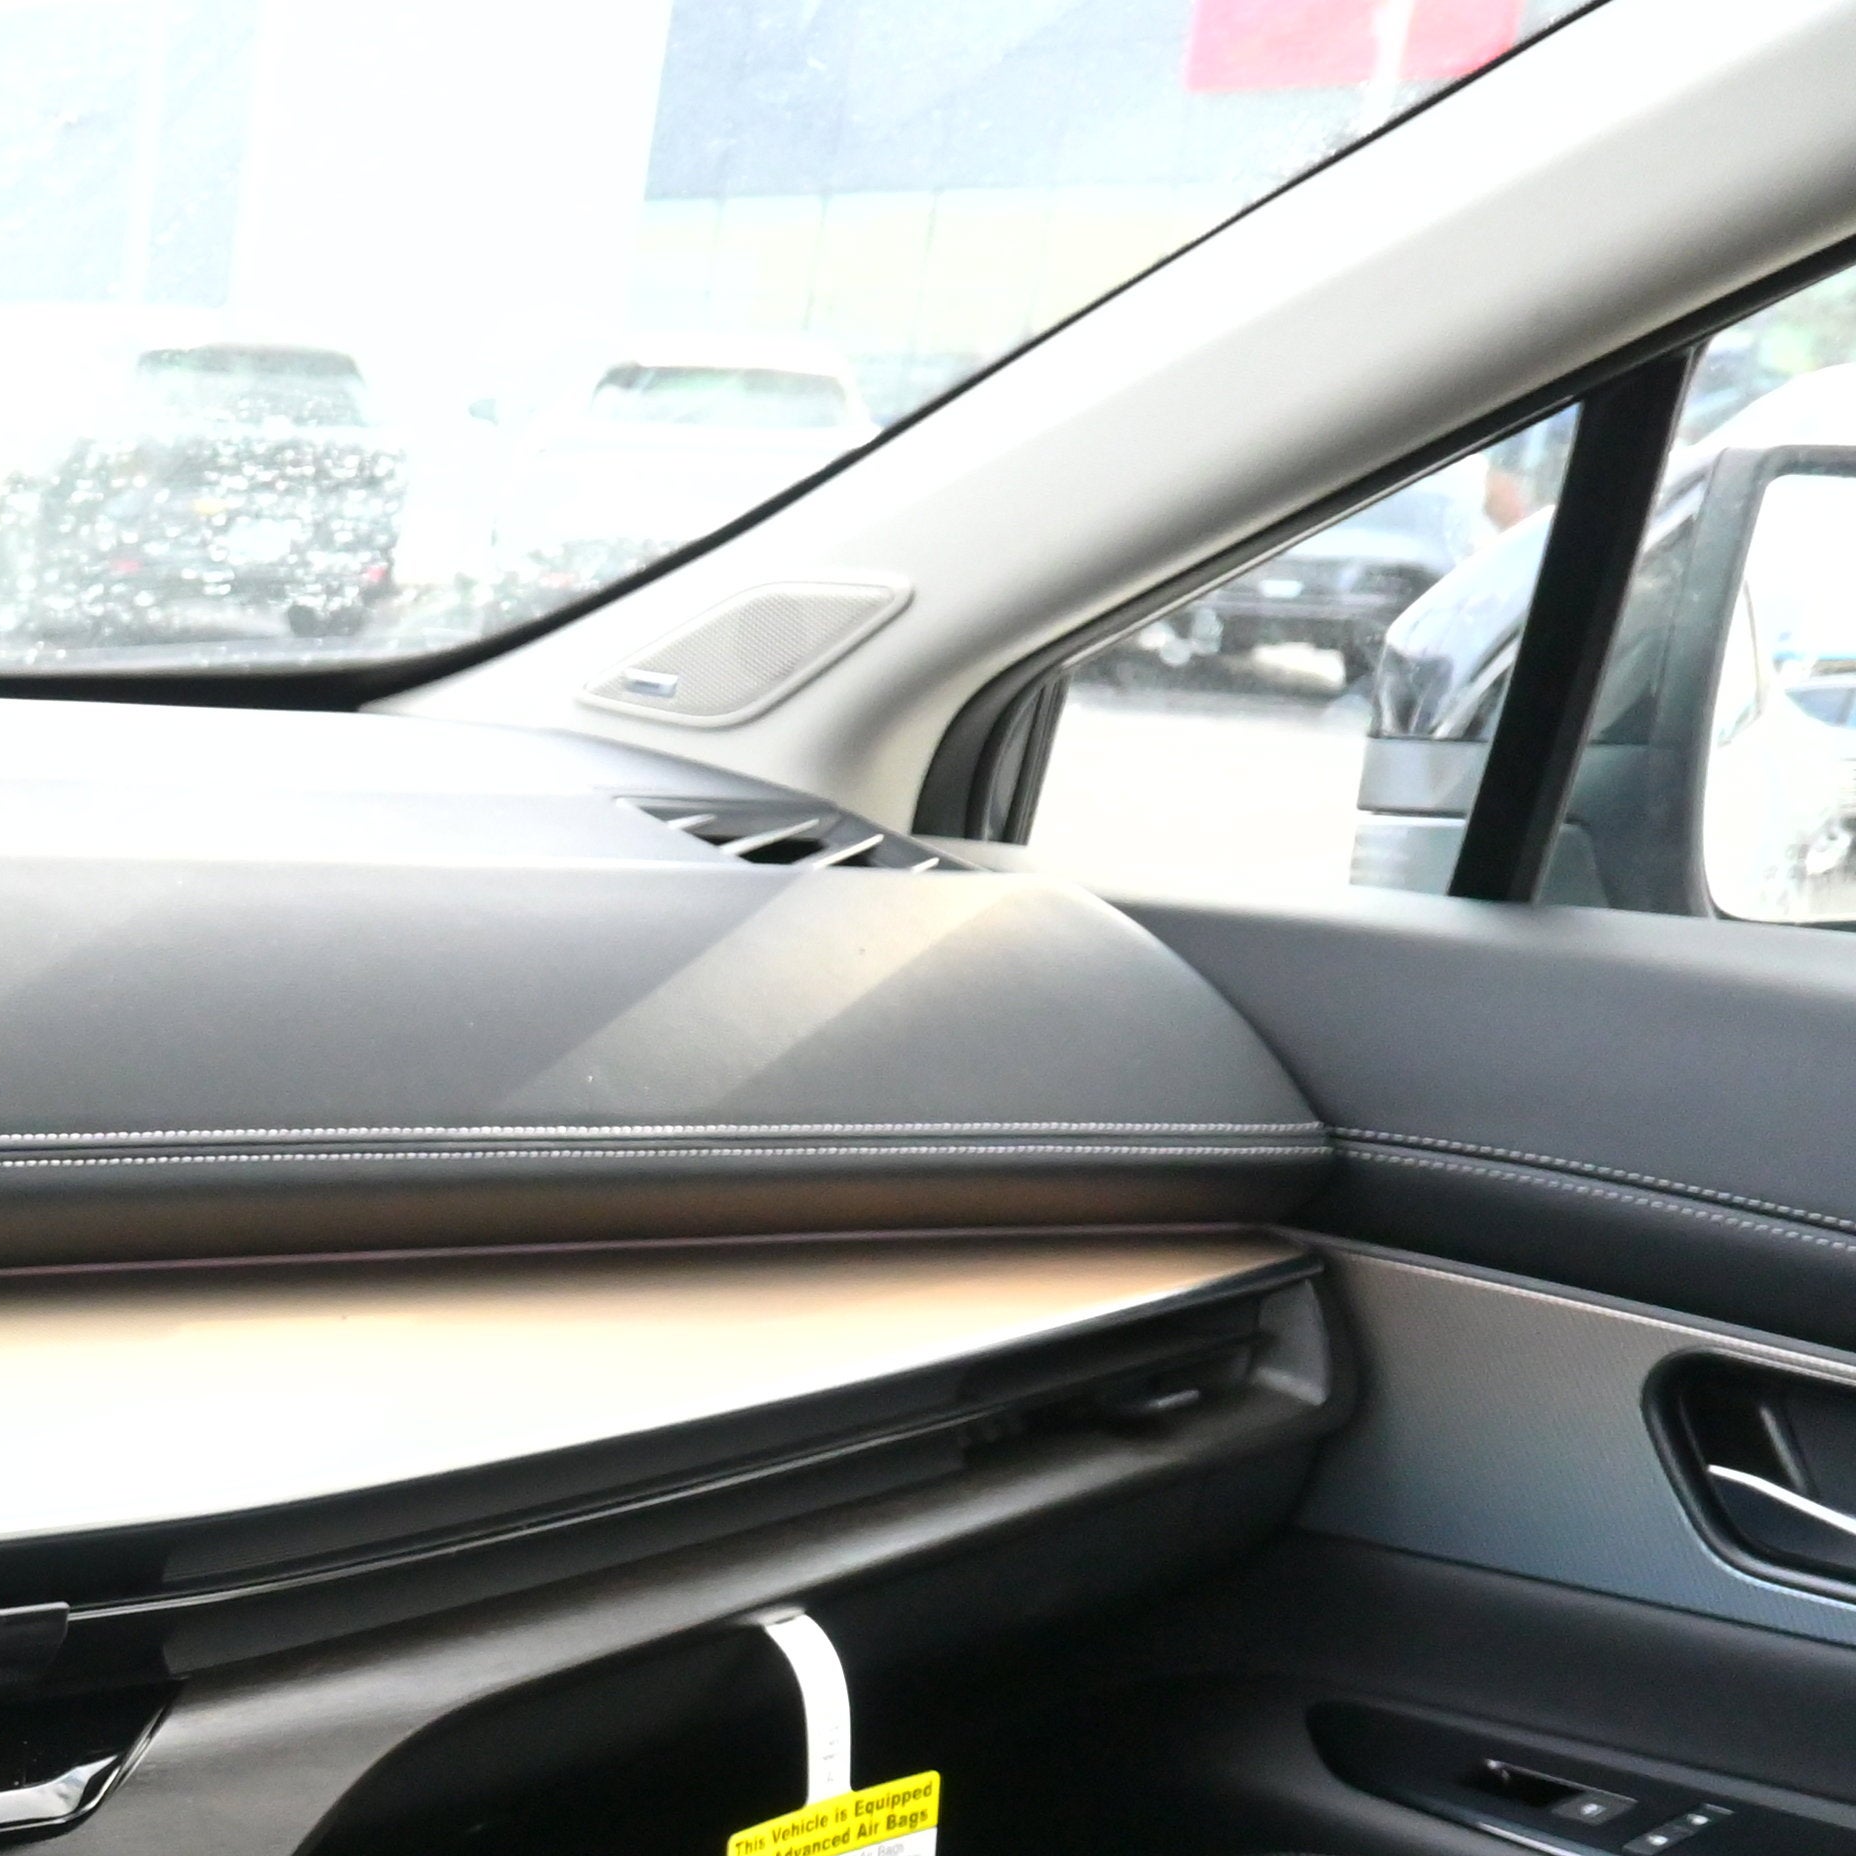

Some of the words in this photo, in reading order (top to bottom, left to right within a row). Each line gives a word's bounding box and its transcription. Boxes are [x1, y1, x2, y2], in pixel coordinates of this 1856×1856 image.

[771, 1814, 828, 1843] Vehicle
[835, 1807, 848, 1822] is
[854, 1780, 933, 1818] Equipped
[857, 1820, 879, 1839] Air
[885, 1808, 928, 1831] Bags
